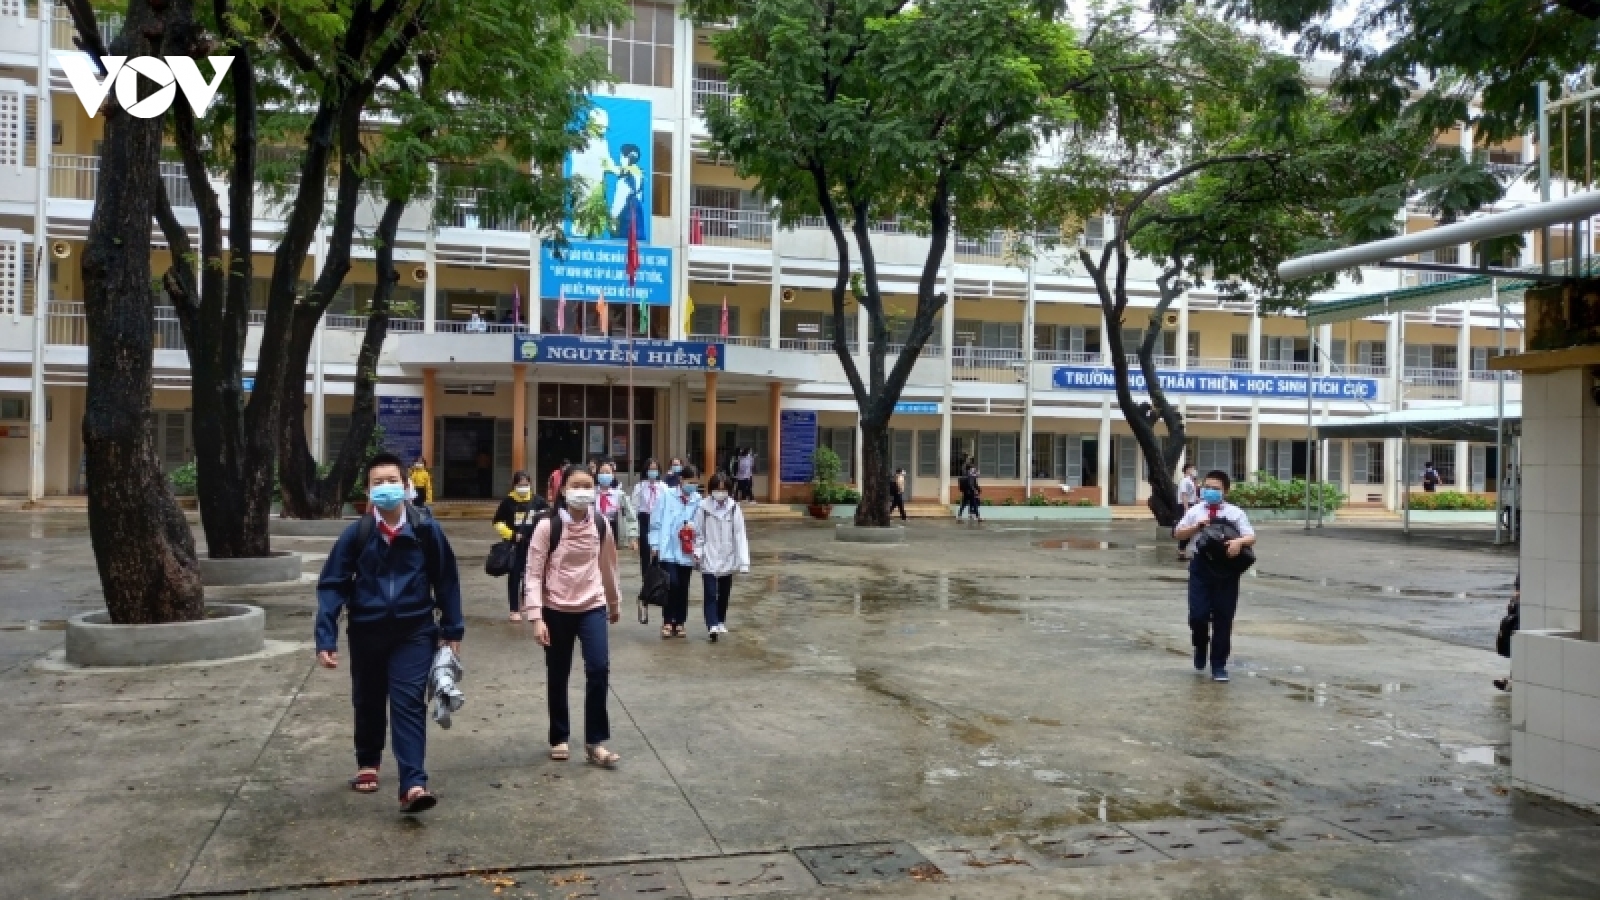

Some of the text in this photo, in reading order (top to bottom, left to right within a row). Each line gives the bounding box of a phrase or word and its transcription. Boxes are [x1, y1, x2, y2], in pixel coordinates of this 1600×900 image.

[1065, 368, 1115, 386] TRƯỜN
[1127, 373, 1145, 391] HỌ
[1157, 373, 1195, 389] THÂN
[1277, 380, 1307, 392] SINH
